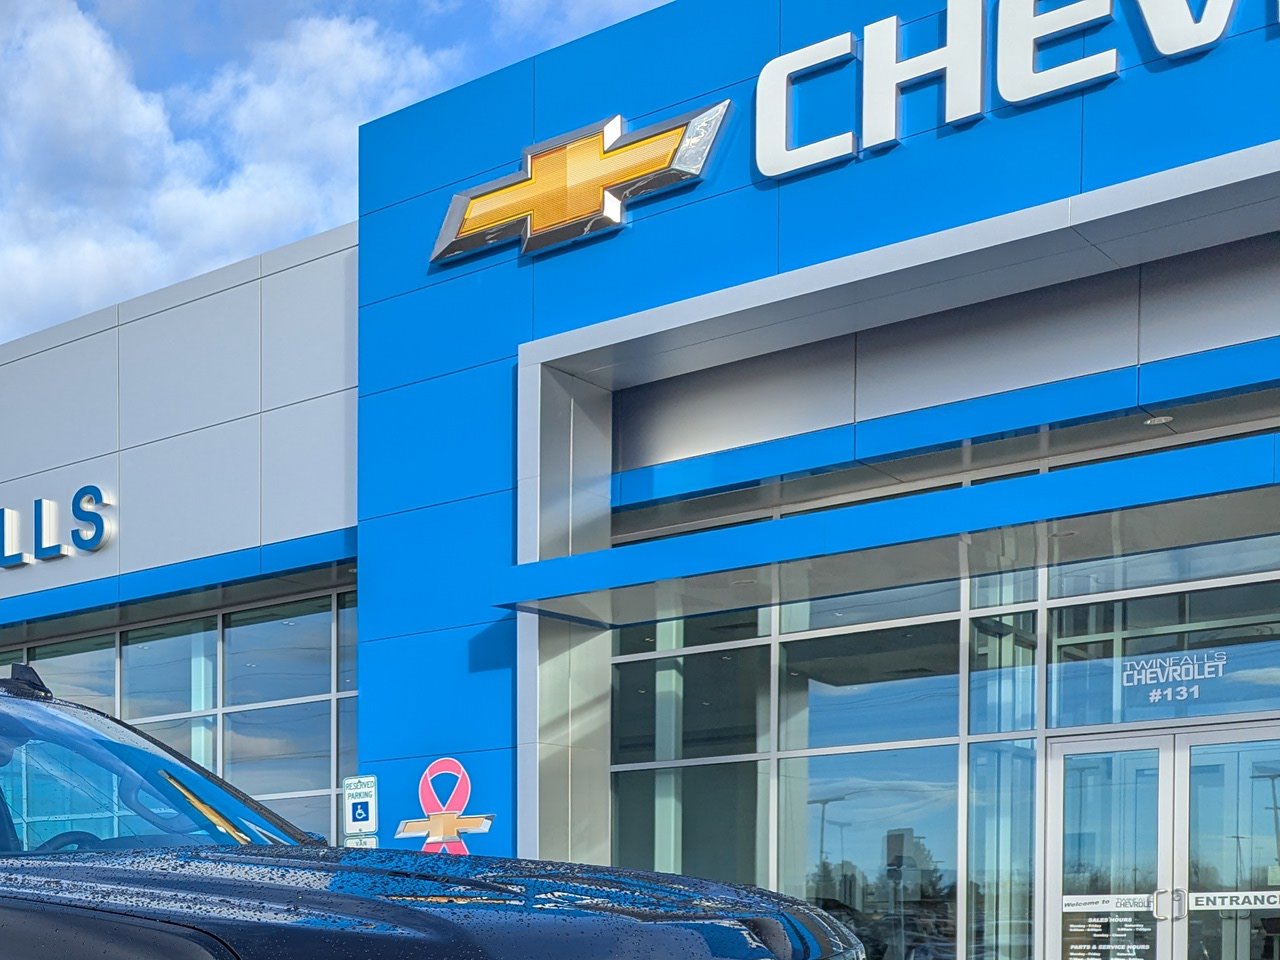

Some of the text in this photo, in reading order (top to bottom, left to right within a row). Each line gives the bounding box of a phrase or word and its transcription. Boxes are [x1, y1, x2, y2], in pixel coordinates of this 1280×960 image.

[1122, 661, 1227, 687] CHEVROLET
[1148, 685, 1200, 703] #131
[345, 780, 375, 790] RESERVED
[347, 790, 373, 800] PARKING
[1064, 900, 1100, 908] Welcome
[1194, 894, 1280, 907] ENTRANC
